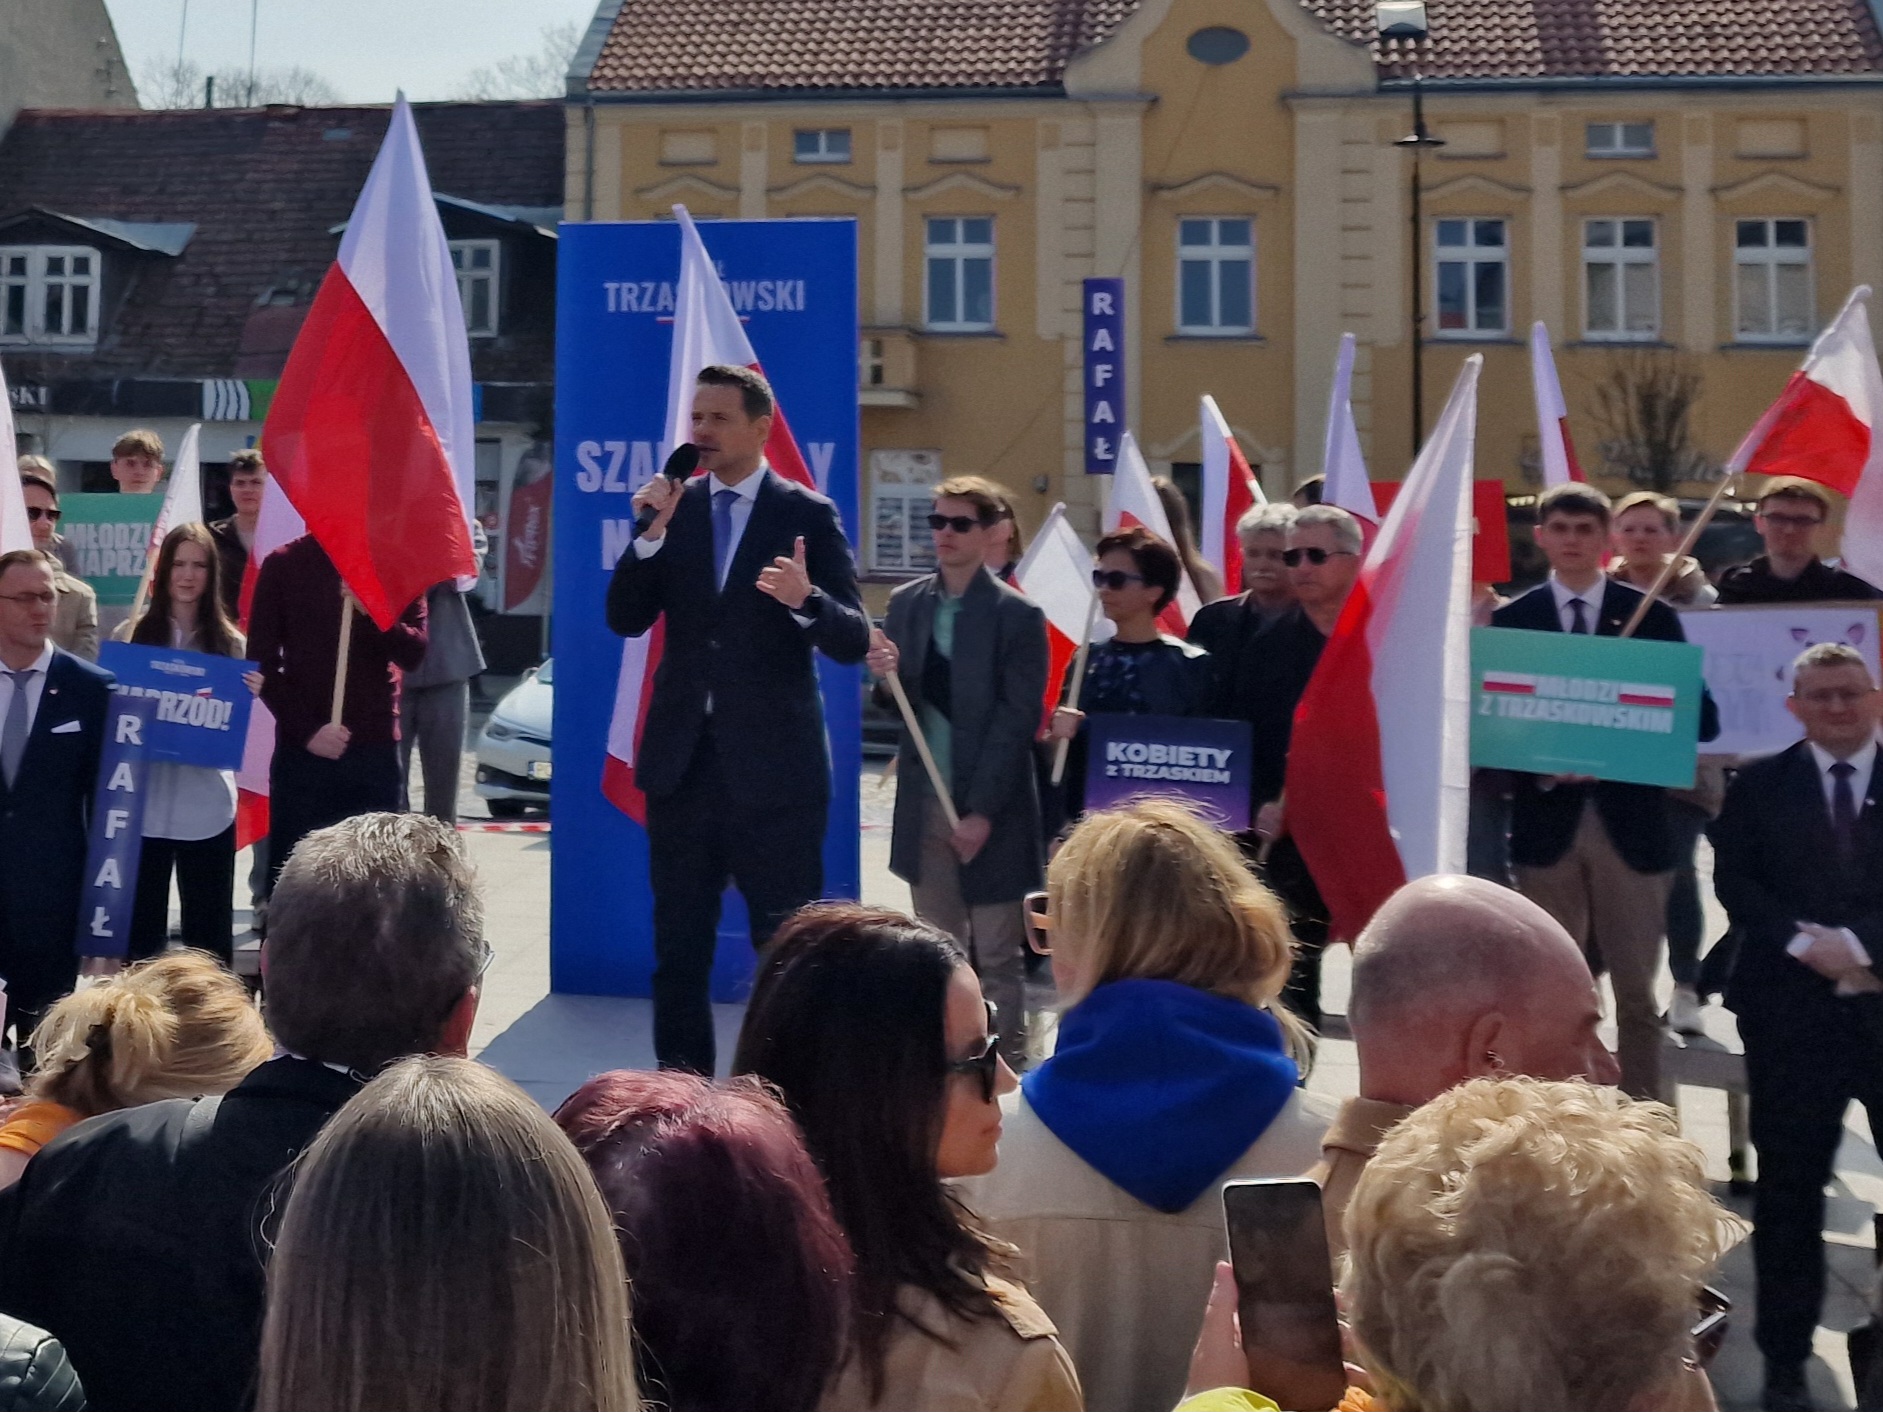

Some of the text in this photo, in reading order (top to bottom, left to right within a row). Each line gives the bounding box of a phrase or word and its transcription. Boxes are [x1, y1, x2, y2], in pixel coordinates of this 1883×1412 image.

[603, 280, 806, 313] TRZAWSKI
[1091, 292, 1116, 460] RAFAŁ
[1497, 697, 1673, 733] TRZASKOWSKIM
[1106, 742, 1233, 768] KOBIETY
[1121, 763, 1231, 784] TRZASKIEM
[91, 714, 143, 937] RAFAŁ
